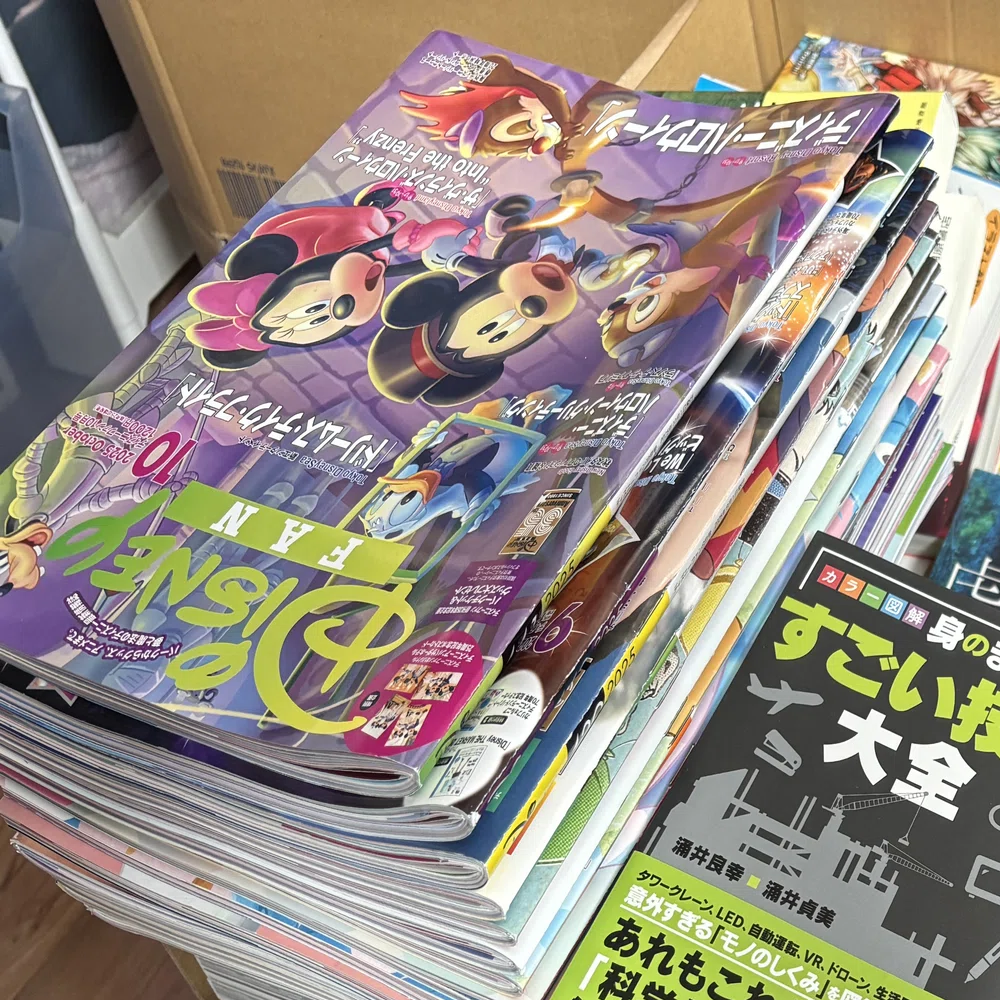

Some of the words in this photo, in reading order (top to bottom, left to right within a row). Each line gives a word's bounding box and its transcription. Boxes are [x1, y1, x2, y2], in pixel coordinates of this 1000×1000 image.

[420, 149, 452, 168] the
[60, 424, 105, 453] October
[102, 441, 135, 465] 2025
[130, 432, 198, 486] 10
[210, 502, 365, 572] FAN
[64, 592, 164, 647] 夢と魔法のディズニー最新情報誌
[821, 567, 928, 627] カラー図解
[604, 645, 640, 694] 2025
[815, 698, 978, 822] 大全
[669, 835, 746, 884] 涌井良幸
[760, 879, 837, 929] 涌井貞美
